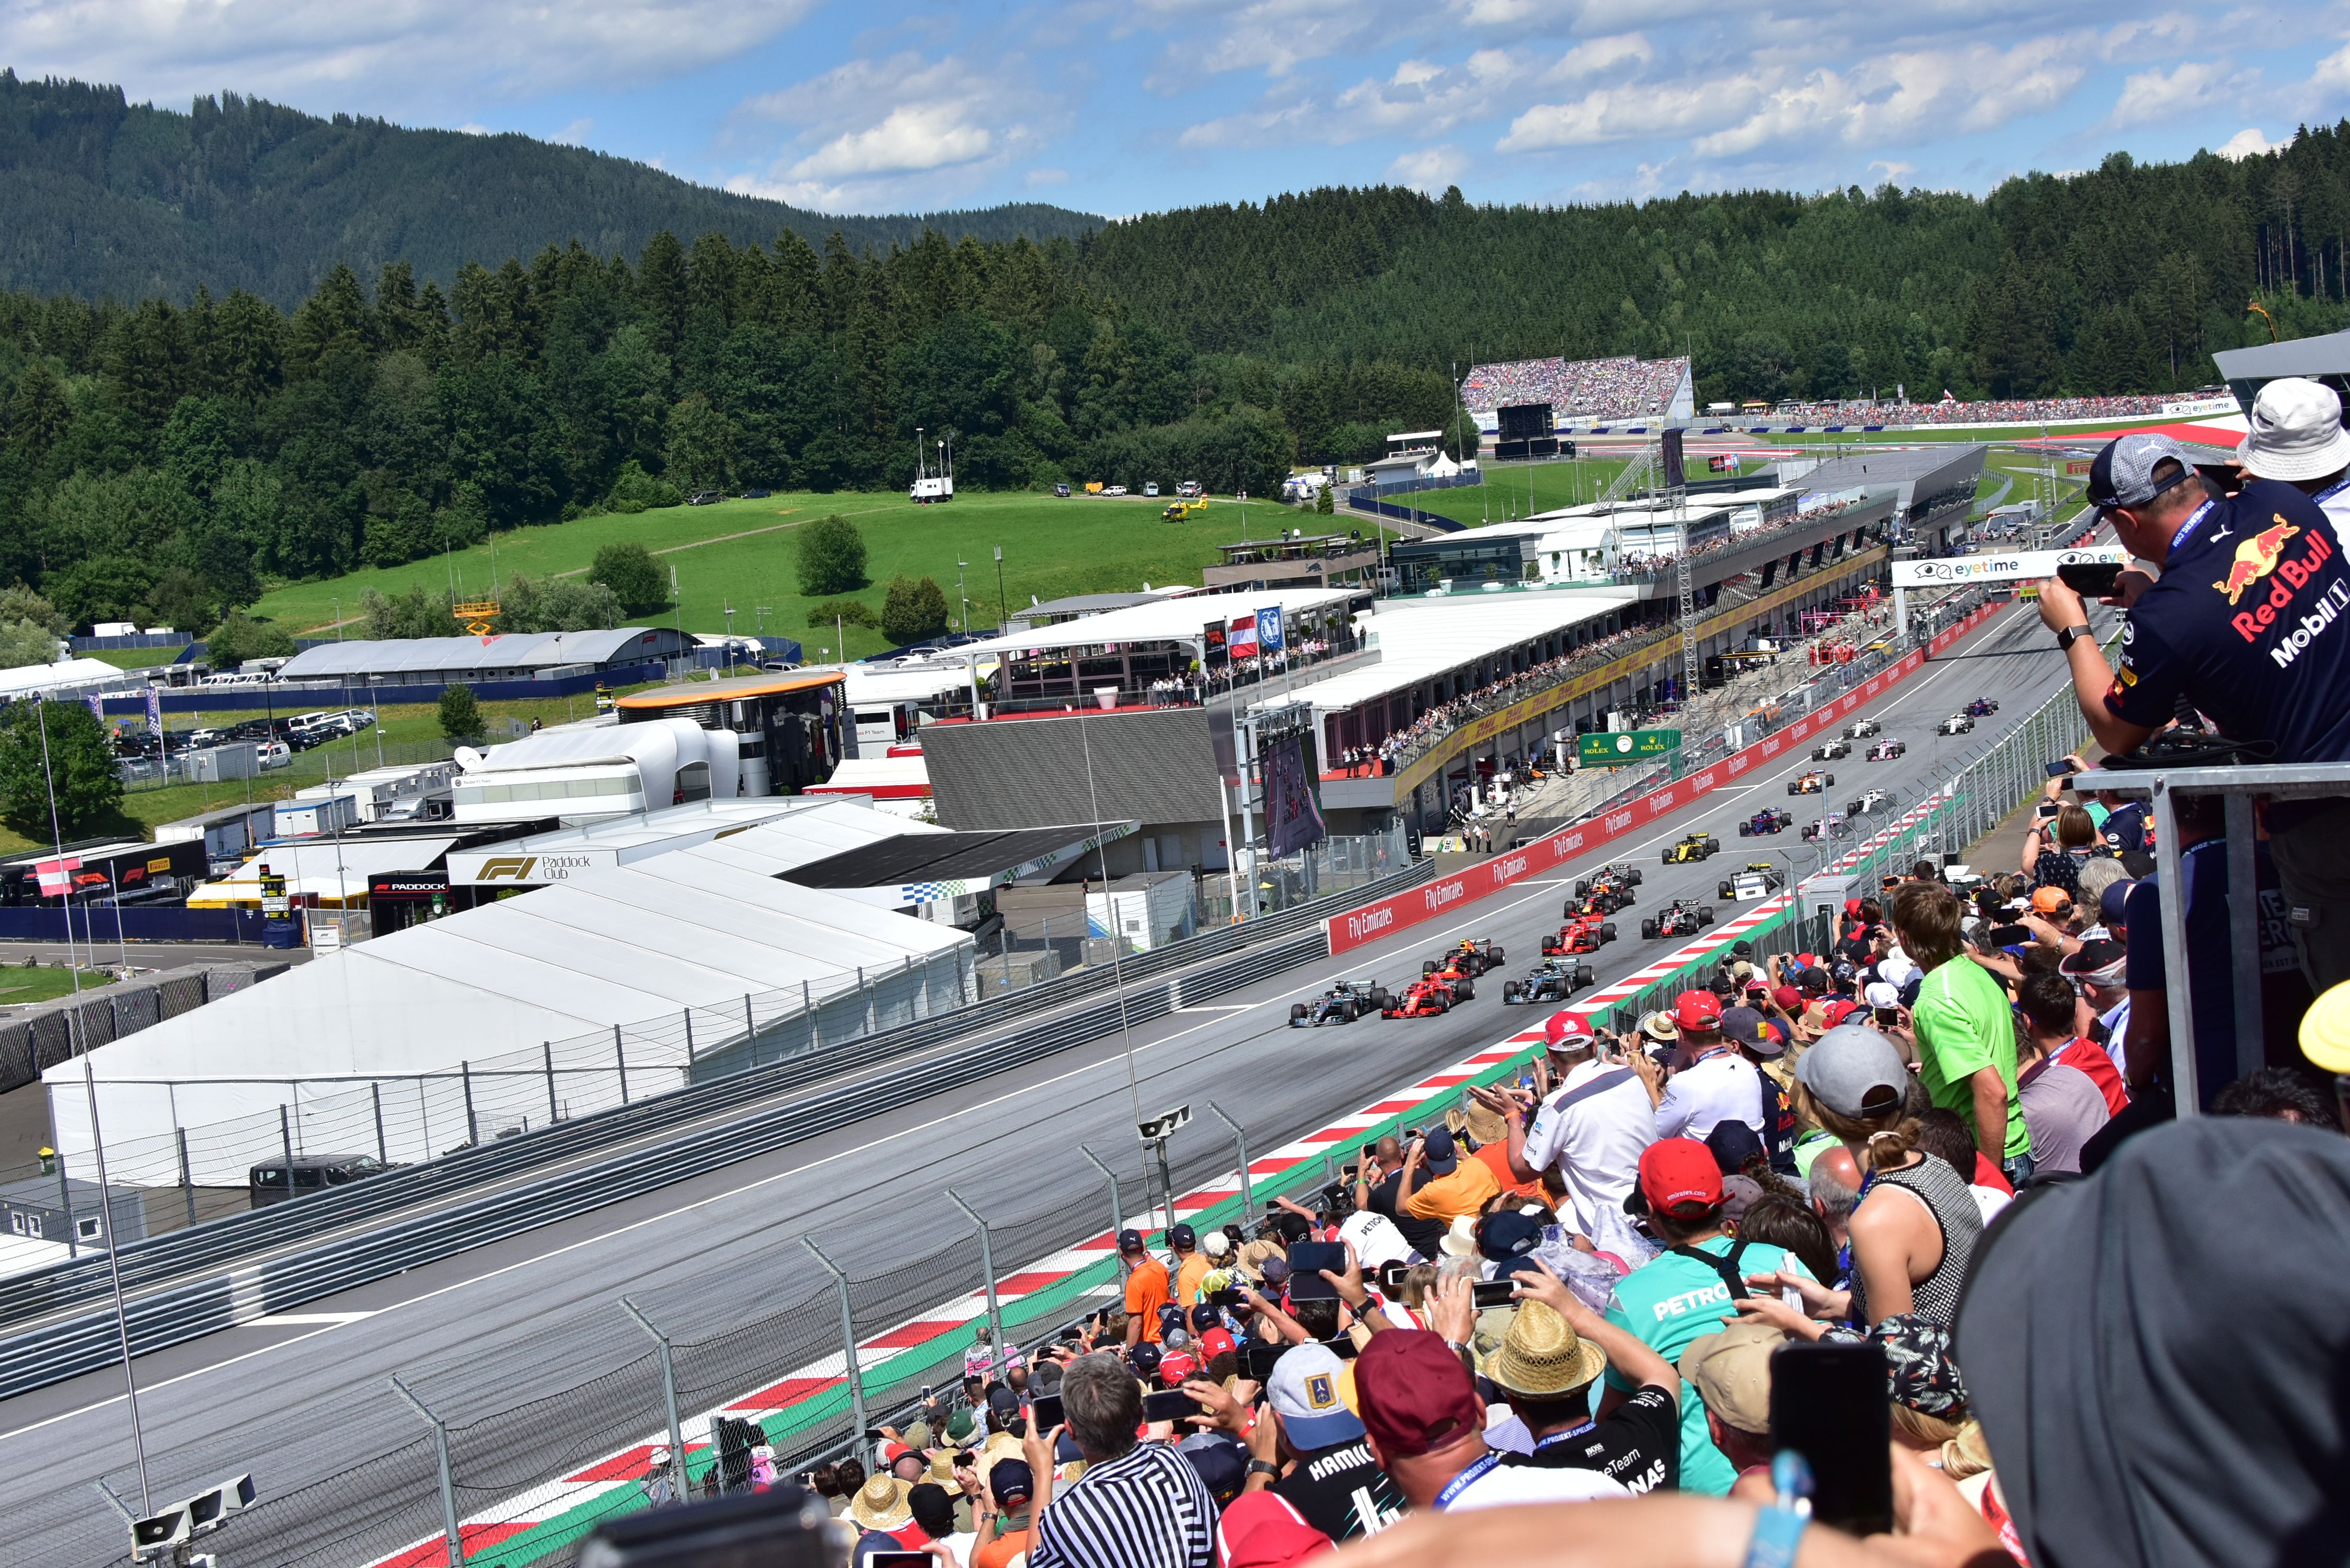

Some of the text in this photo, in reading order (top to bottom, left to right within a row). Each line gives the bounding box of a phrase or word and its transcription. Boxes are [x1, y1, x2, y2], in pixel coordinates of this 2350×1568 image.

[2193, 402, 2229, 413] eyetime
[1955, 558, 2018, 577] eyetime
[2231, 528, 2333, 643] Red Bull
[2270, 597, 2337, 668] Mobil
[1796, 722, 1807, 737] Emirates
[1767, 738, 1779, 754] Emirates
[1734, 755, 1747, 772] Emirates
[1699, 771, 1714, 790] Emirates
[1650, 790, 1673, 815] Fly Emirates
[1605, 810, 1631, 835] Fly Emirates
[1553, 831, 1583, 858] Fly Emirates
[149, 859, 169, 870] PIRELLI
[542, 855, 591, 868] Paddock
[1493, 855, 1527, 884] Fly Emirates
[544, 867, 568, 880] Club
[1425, 879, 1464, 911] Fly Emirates
[1348, 906, 1393, 940] Fly Emirates
[1666, 1190, 1707, 1201] emirates.com
[1584, 1443, 1604, 1456] BOSS
[1308, 1443, 1376, 1482] HAMIL
